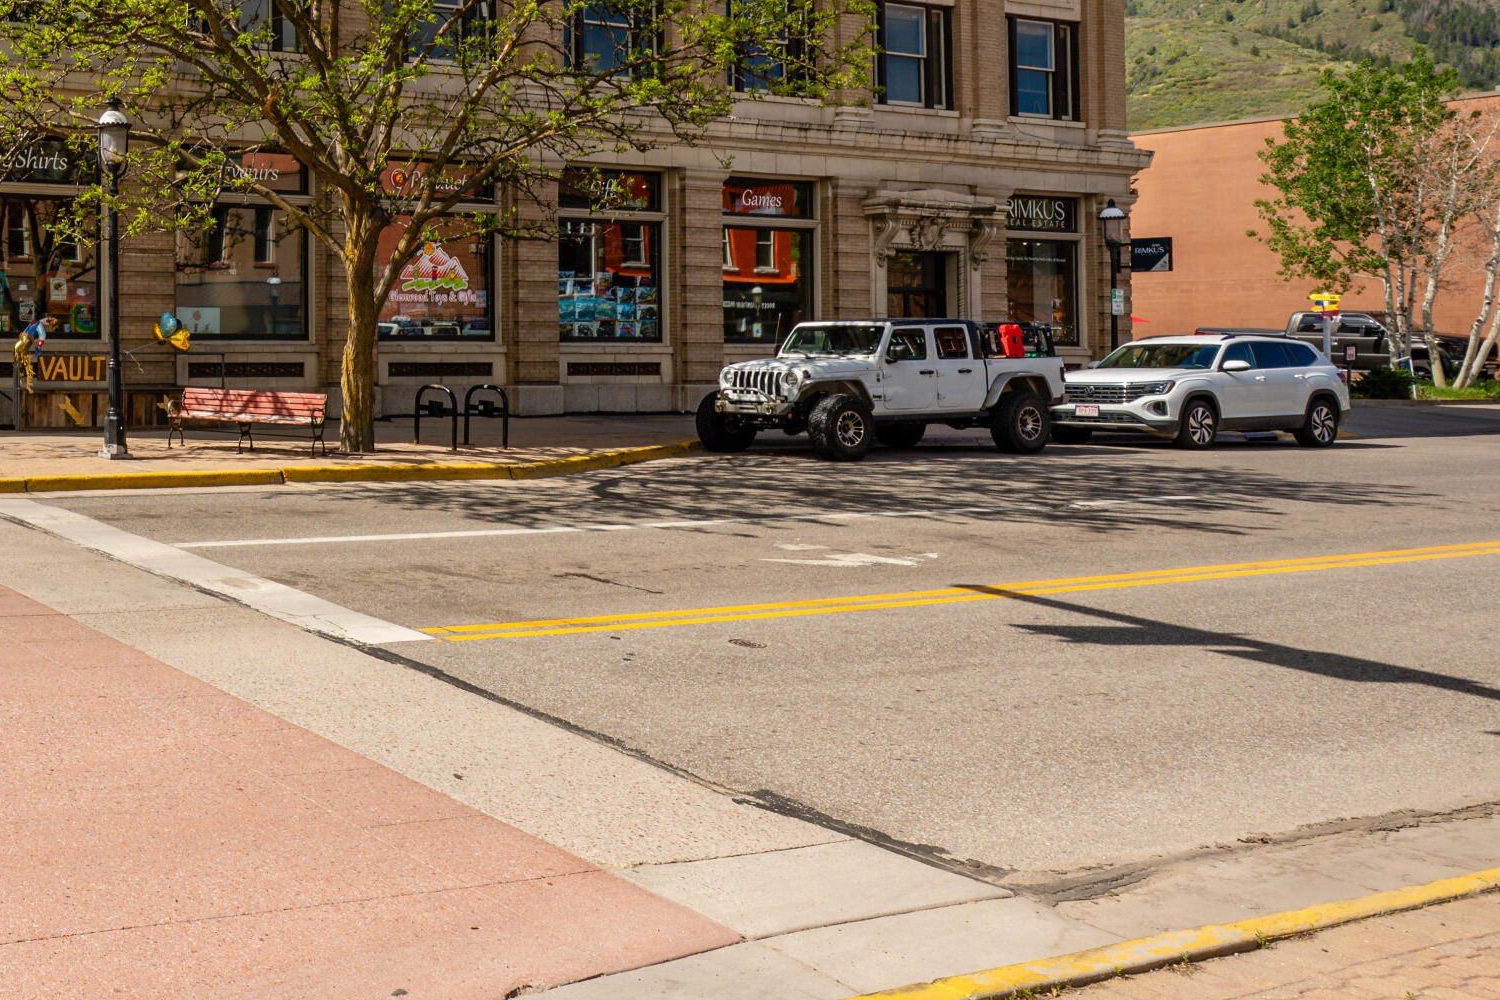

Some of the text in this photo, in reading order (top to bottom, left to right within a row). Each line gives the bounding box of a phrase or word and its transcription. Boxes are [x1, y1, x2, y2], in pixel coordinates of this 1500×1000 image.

[15, 146, 68, 170] Shirts
[742, 189, 782, 207] Games
[1006, 199, 1065, 220] RIMKUS
[1032, 219, 1065, 228] ESTATE
[1134, 246, 1165, 256] RIMKUS
[429, 291, 448, 306] Toys
[39, 355, 107, 381] VAULT
